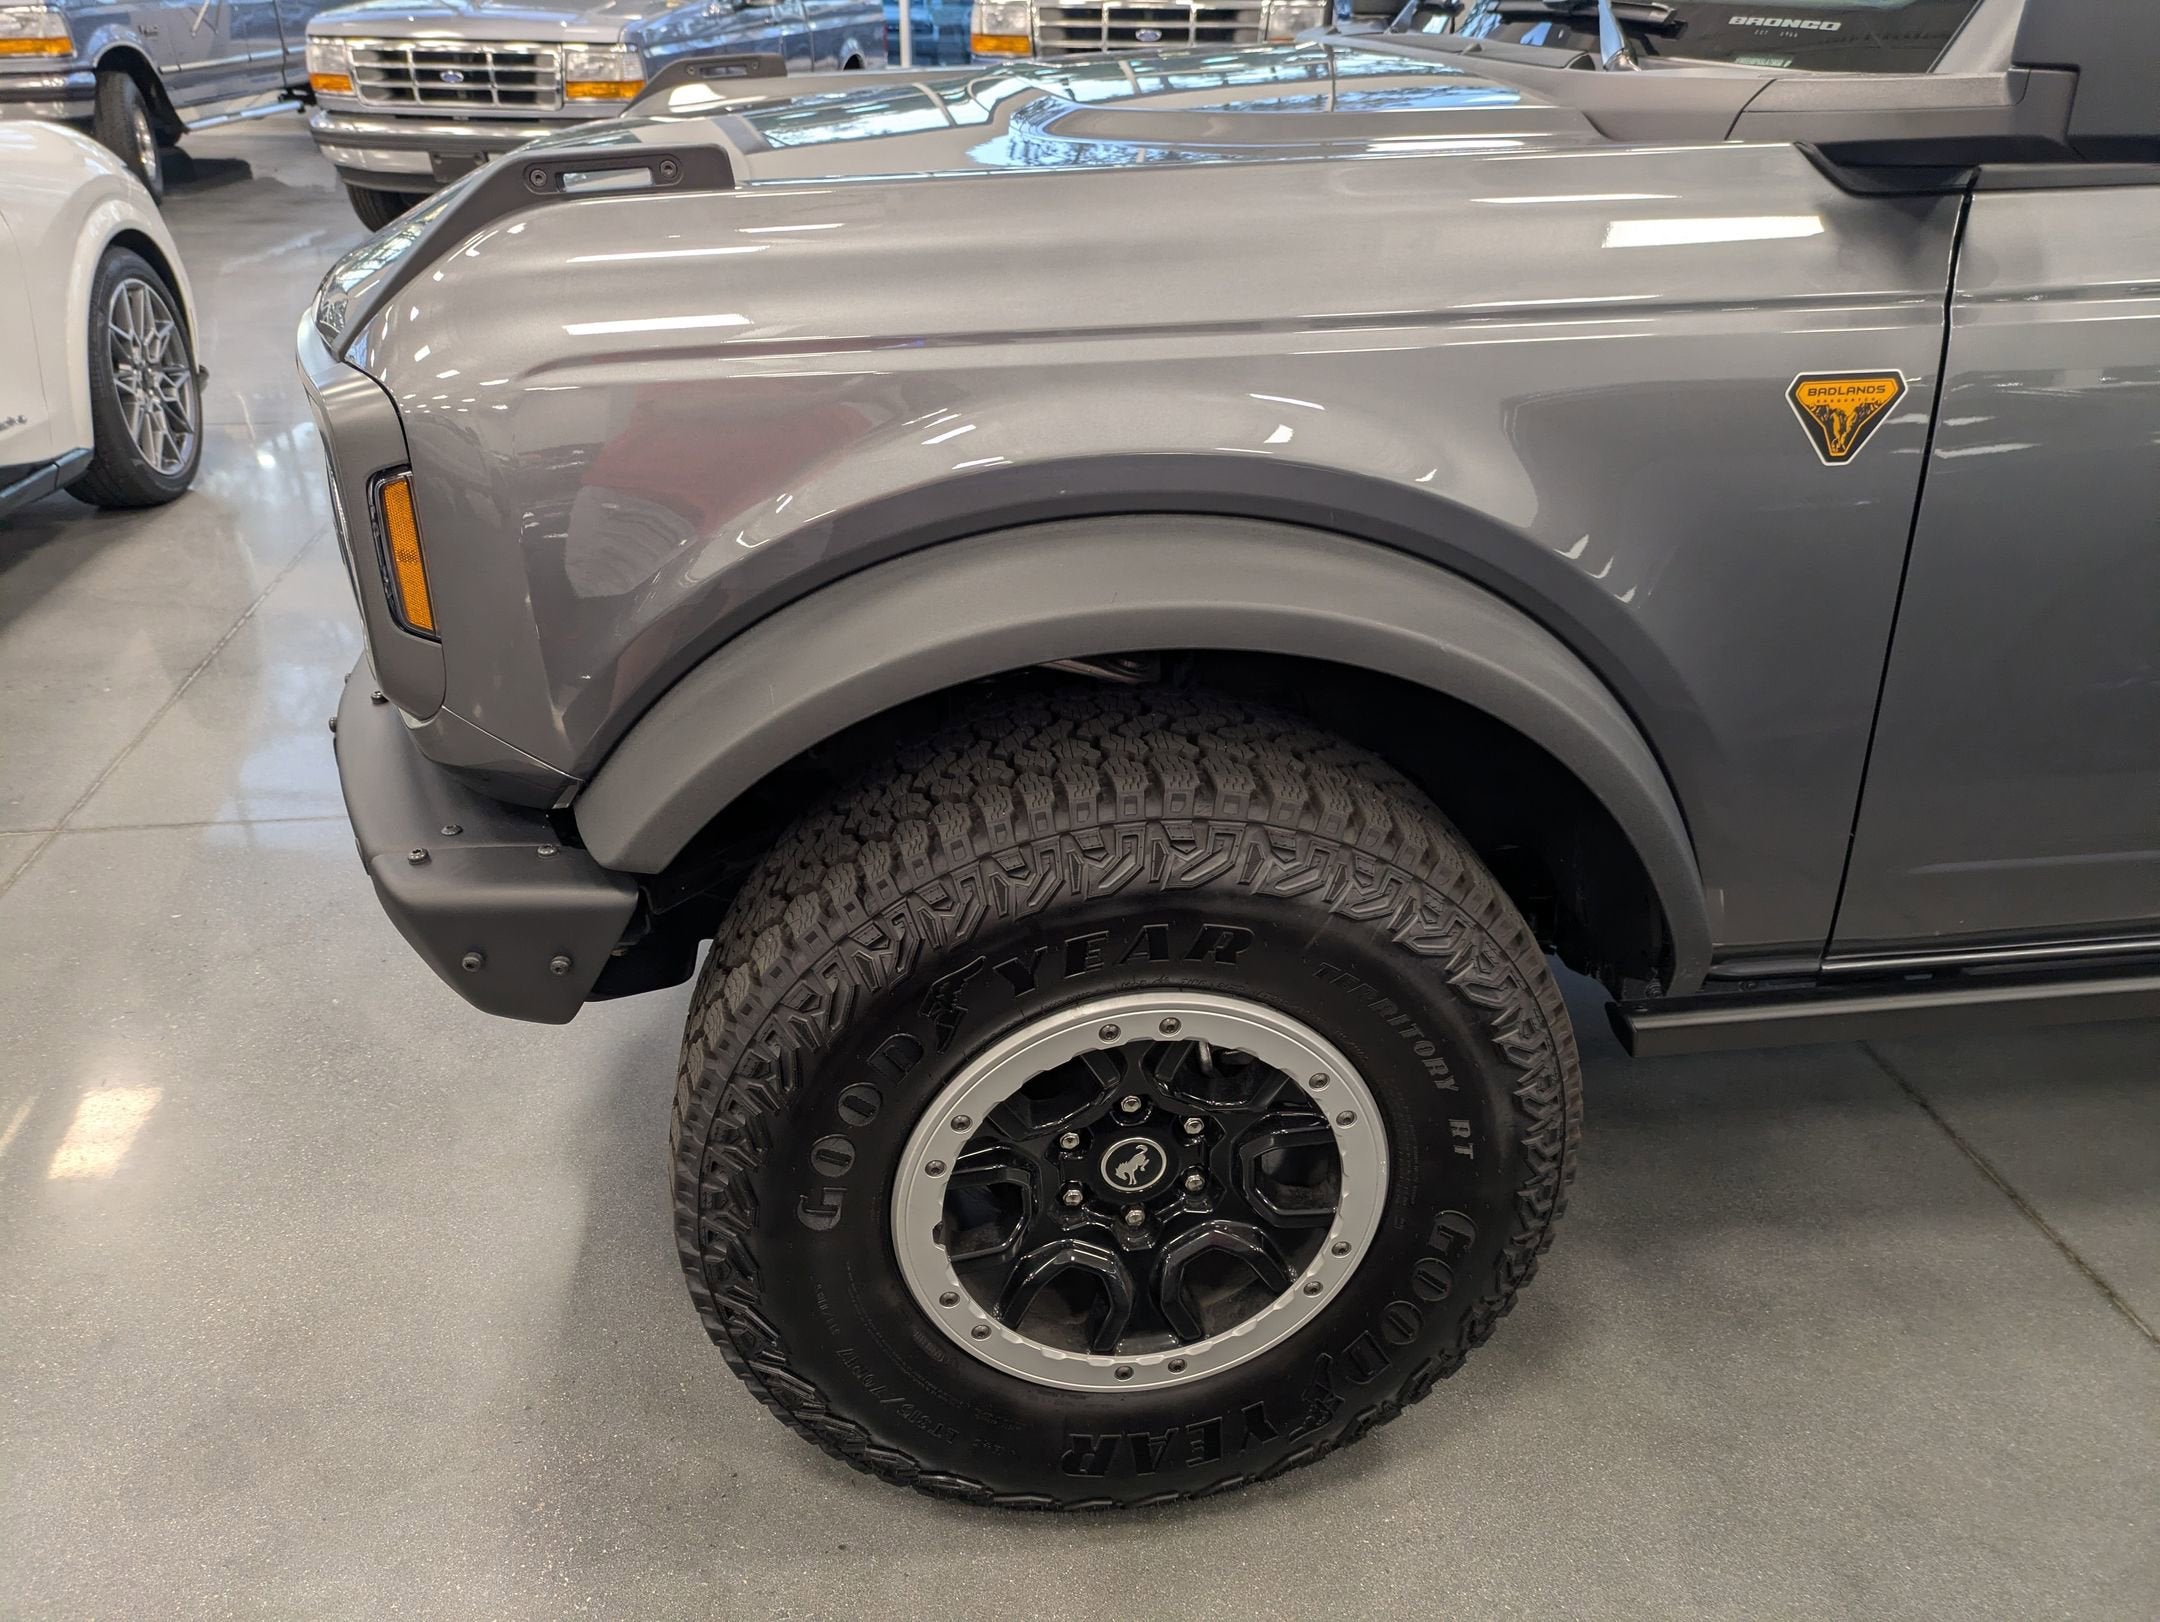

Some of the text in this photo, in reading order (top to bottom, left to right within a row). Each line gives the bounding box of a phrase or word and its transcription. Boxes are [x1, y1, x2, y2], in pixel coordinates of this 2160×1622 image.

[1728, 16, 1842, 31] BRONCO
[1808, 385, 1886, 396] BADLANDS
[1312, 961, 1475, 1160] TERRITORY RT
